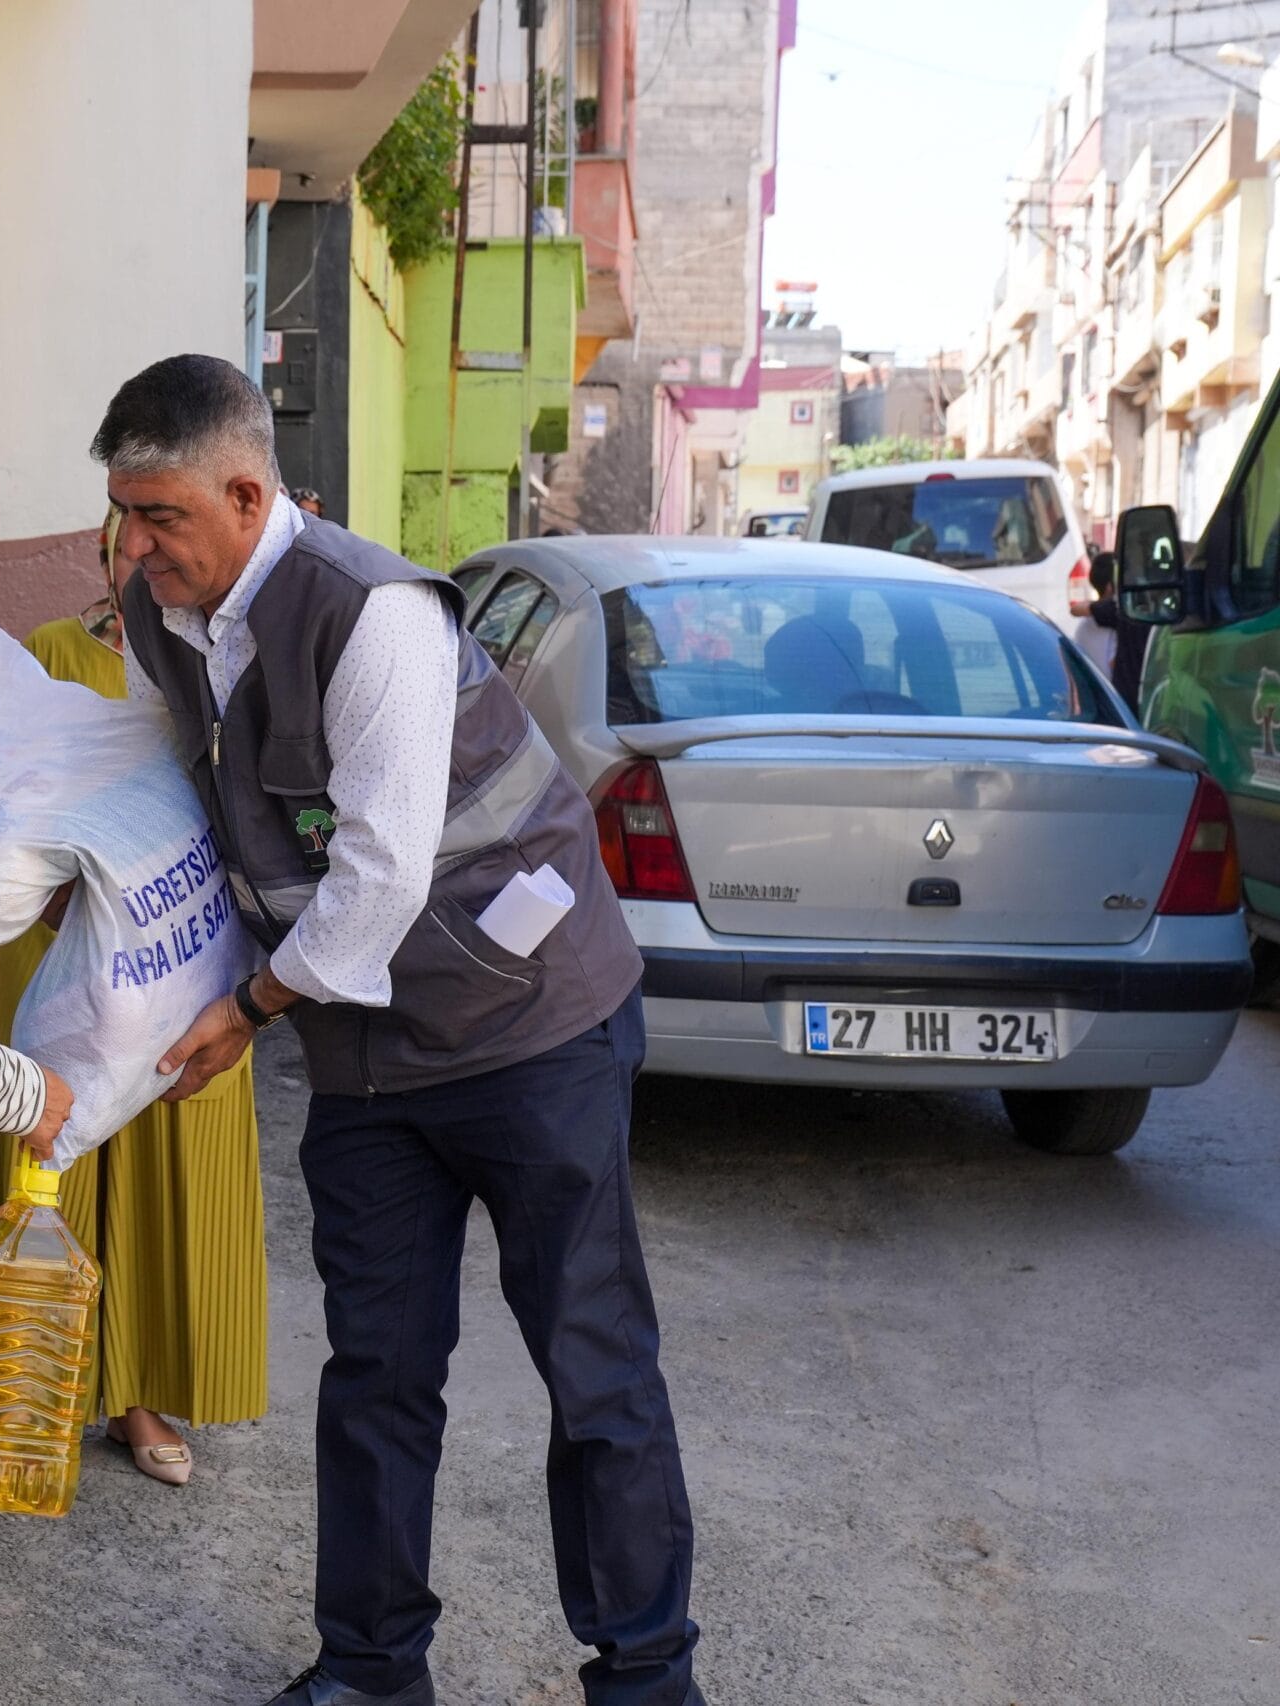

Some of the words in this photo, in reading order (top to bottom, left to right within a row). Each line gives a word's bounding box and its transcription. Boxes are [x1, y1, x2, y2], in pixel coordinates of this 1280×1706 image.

[170, 914, 202, 967] İLE
[810, 1031, 827, 1045] TR
[831, 1009, 876, 1049] 27
[905, 1011, 950, 1052] HH
[978, 1013, 1047, 1055] 324
